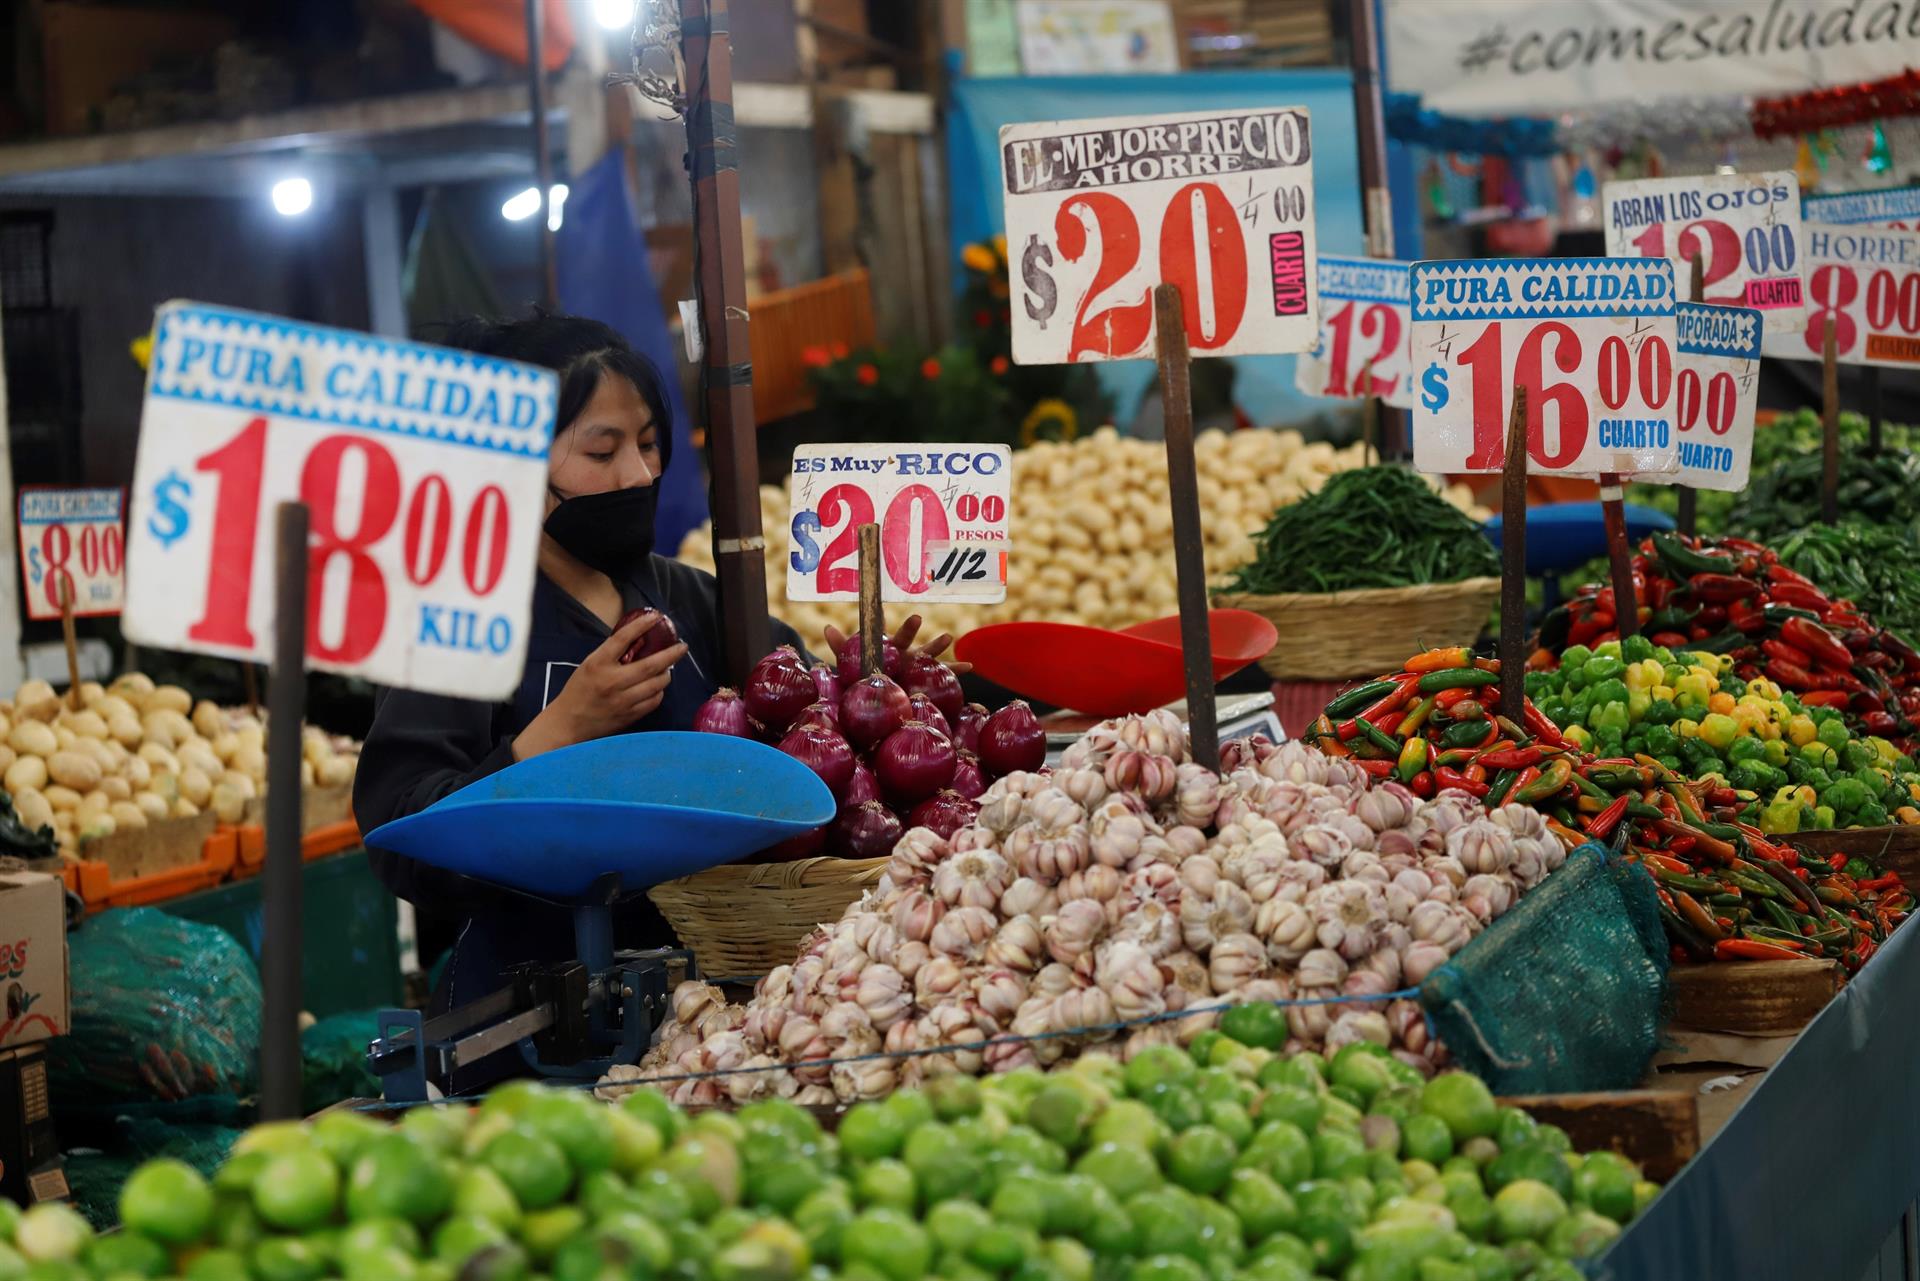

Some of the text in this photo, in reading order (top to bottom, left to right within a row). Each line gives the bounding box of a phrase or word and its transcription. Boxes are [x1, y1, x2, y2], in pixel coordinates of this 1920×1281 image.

[1012, 113, 1301, 193] EL MEJOR PRECIO
[1075, 154, 1244, 187] AHORRE
[1612, 186, 1789, 229] ABRAN LOS OJOS
[1272, 232, 1306, 314] CUARTO
[1425, 273, 1667, 304] PURA CALIDAD
[1751, 281, 1800, 305] CUARTO
[176, 337, 538, 430] PURA CALIDAD
[1599, 418, 1669, 448] CUARTO
[794, 452, 1002, 475] ES Muy RICO
[955, 530, 1004, 541] PESOS
[417, 602, 512, 655] KILO
